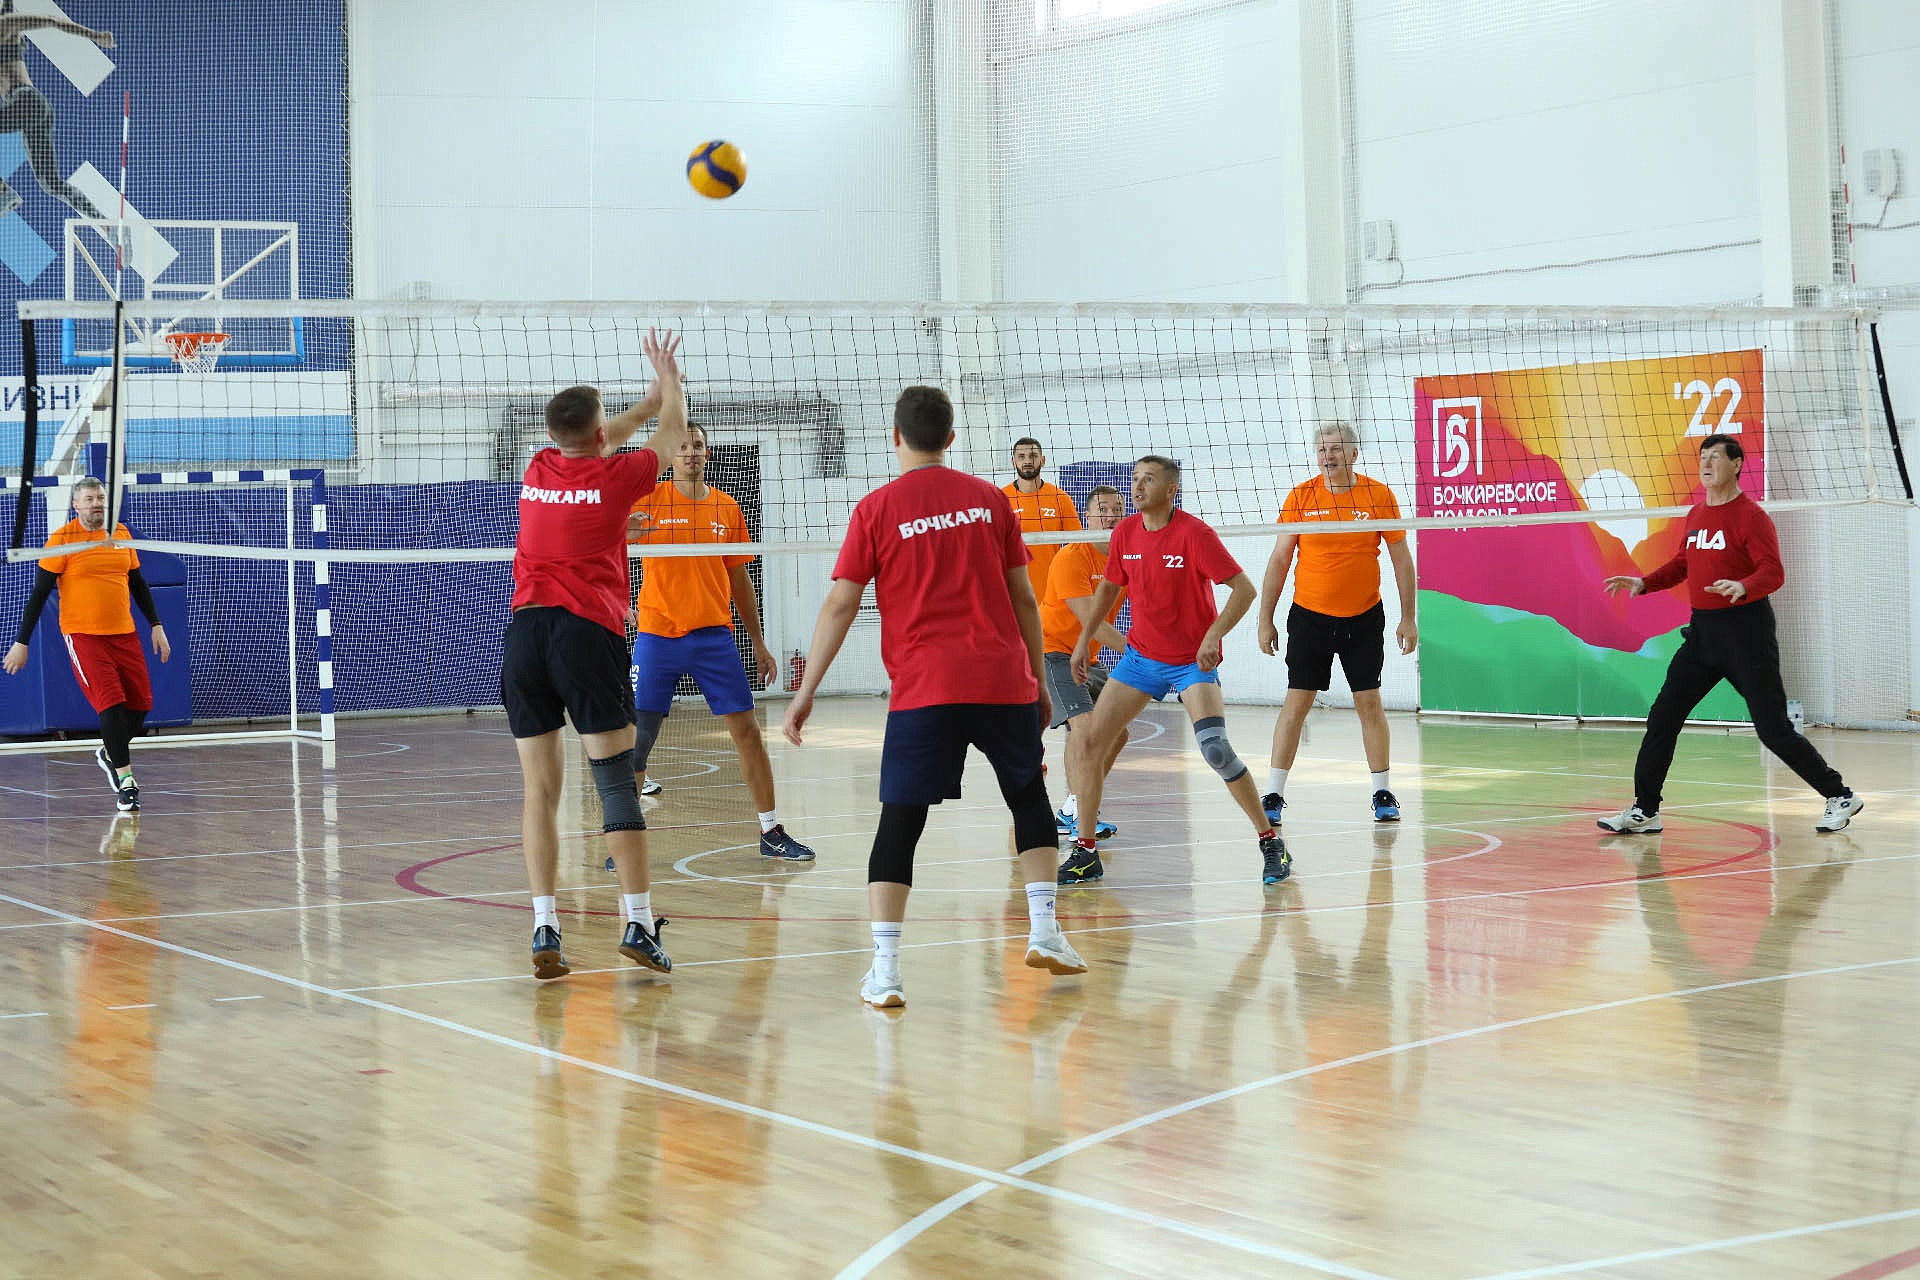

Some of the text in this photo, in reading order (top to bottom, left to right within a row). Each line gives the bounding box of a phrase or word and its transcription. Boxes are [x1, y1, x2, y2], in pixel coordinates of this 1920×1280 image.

[1674, 378, 1743, 437] '22
[520, 484, 601, 504] БОЧКАРИ
[1433, 481, 1557, 506] БОЧКАРЕВСКОЕ
[898, 507, 992, 540] БОЧКАРИ
[1686, 529, 1726, 550] FILA
[1162, 555, 1185, 568] '22
